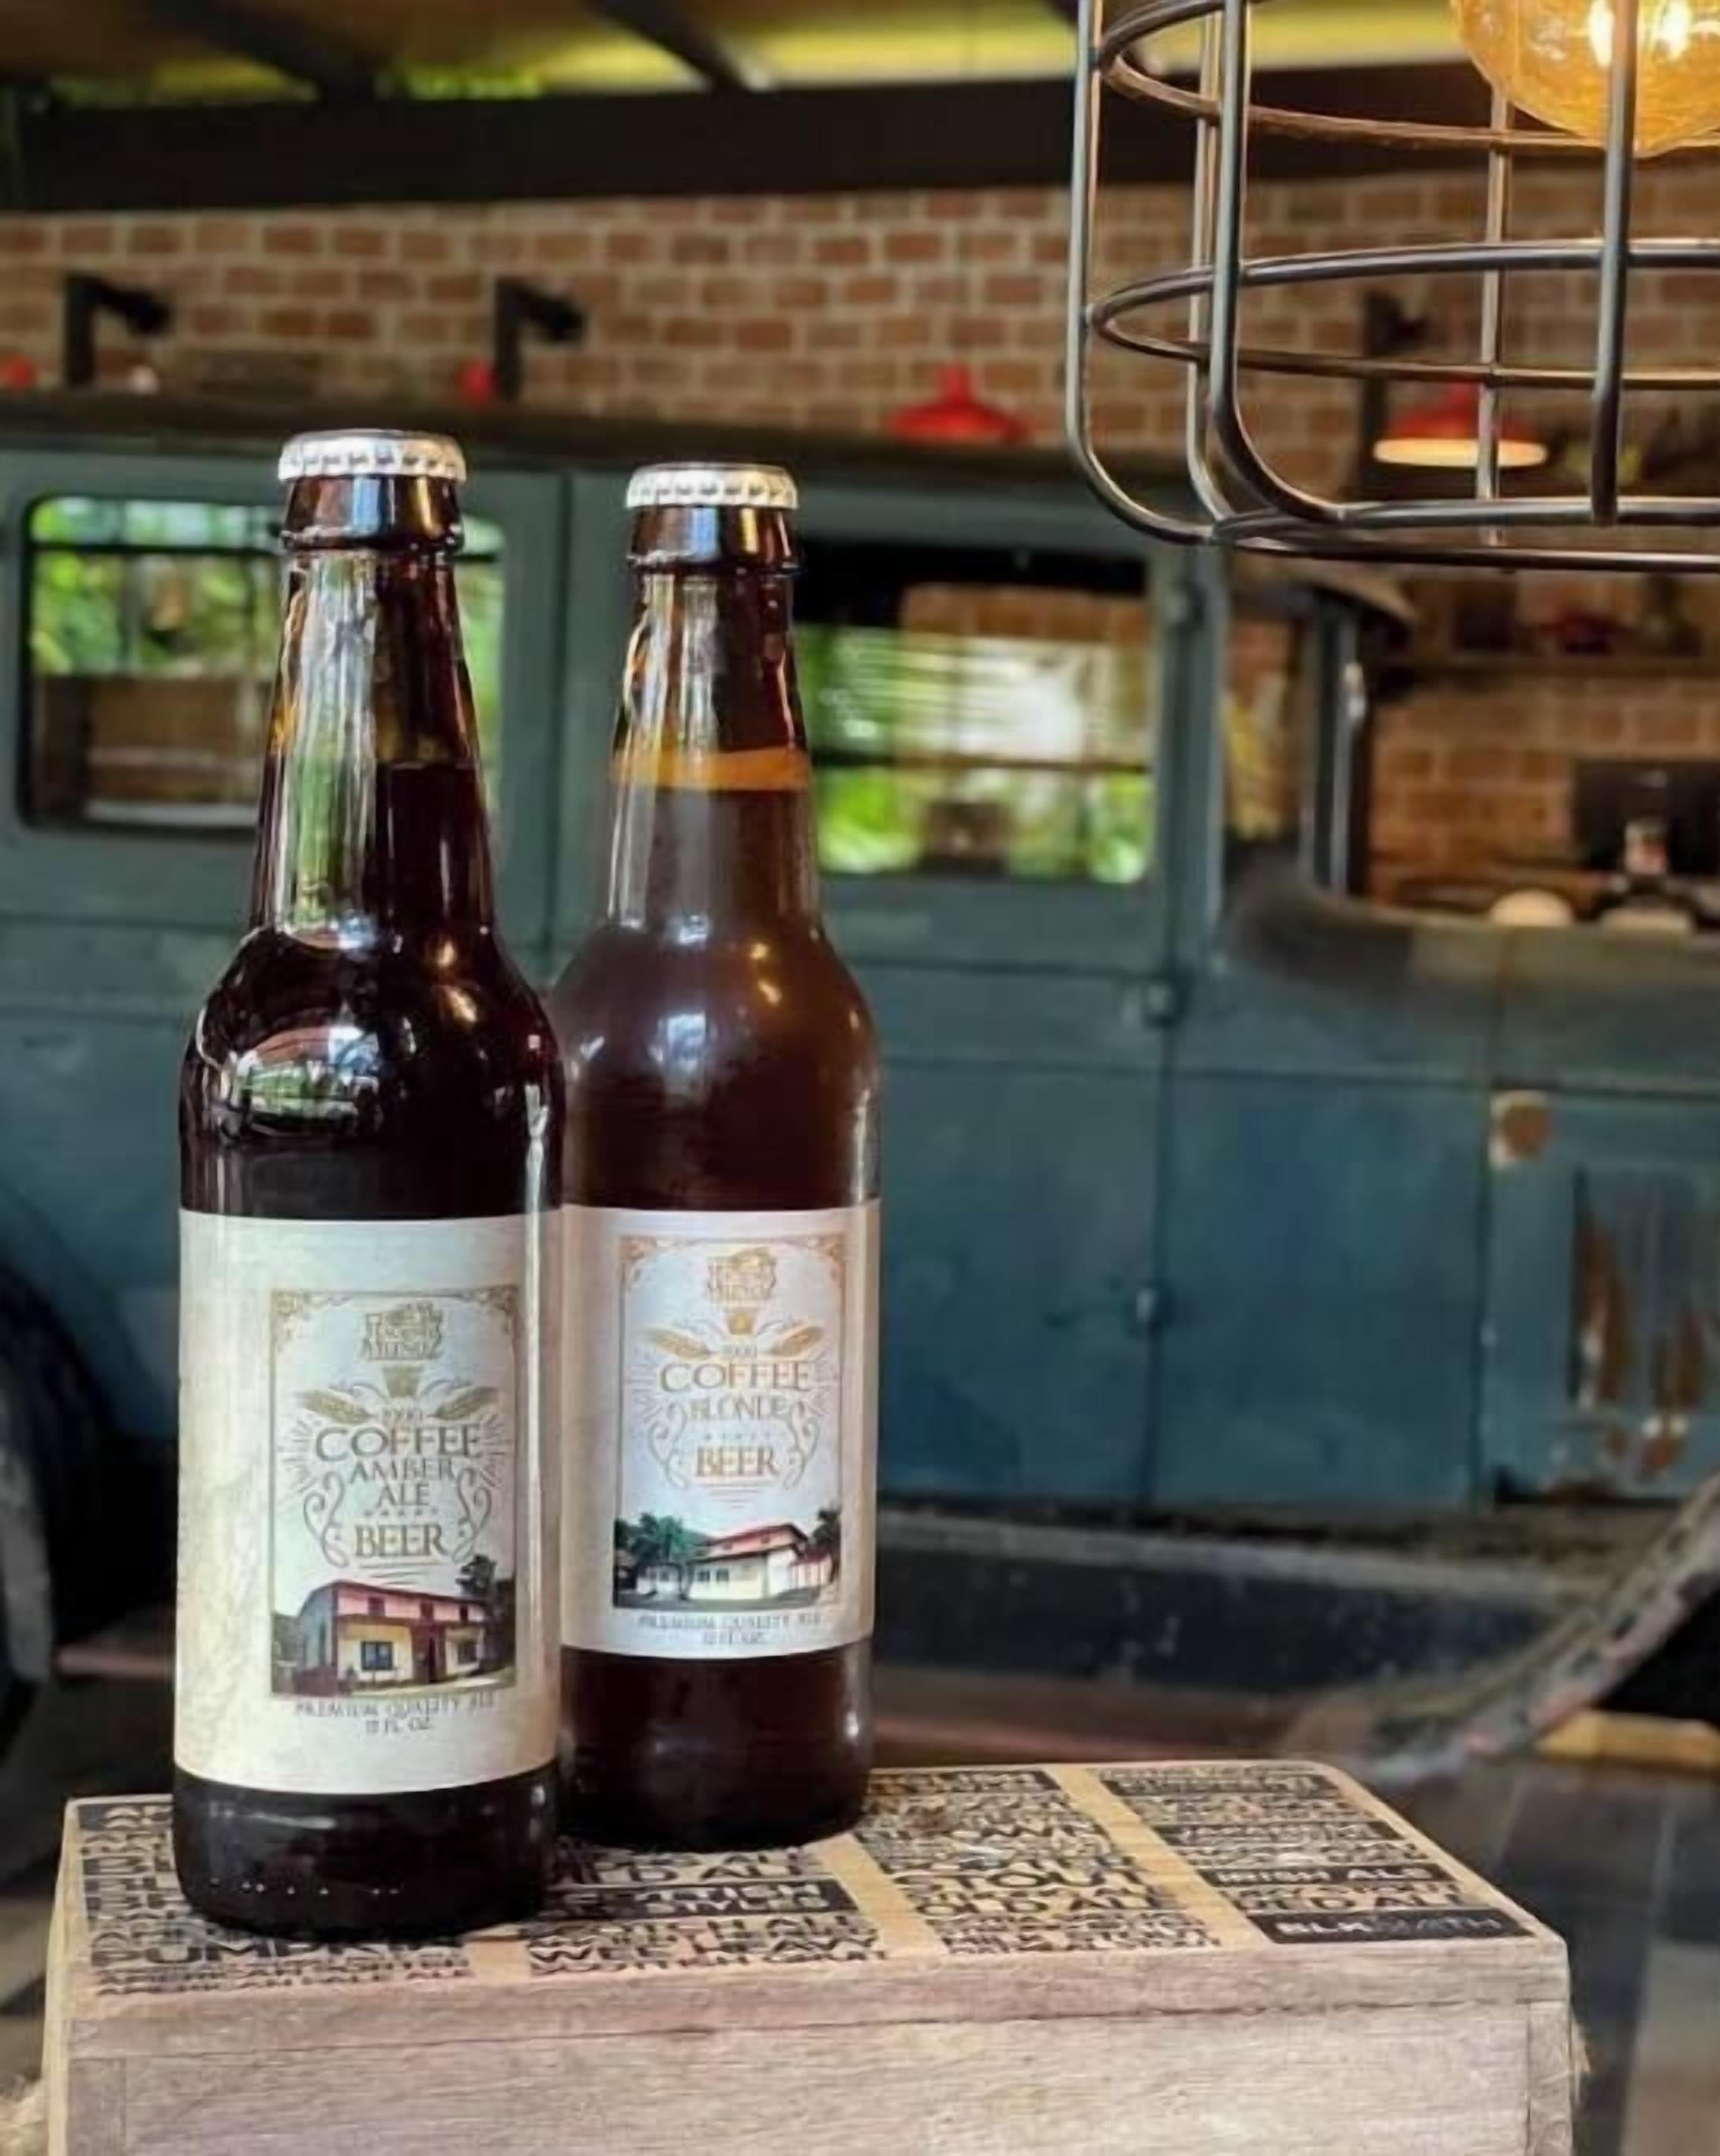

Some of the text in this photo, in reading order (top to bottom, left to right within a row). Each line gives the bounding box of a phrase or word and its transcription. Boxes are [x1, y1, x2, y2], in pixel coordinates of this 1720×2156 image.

[660, 1361, 811, 1392] COFFEE
[690, 1394, 790, 1420] BLONDE
[316, 1424, 483, 1462] COFFEE
[350, 1458, 454, 1484] AMBER
[695, 1446, 780, 1477] BEER
[376, 1483, 429, 1508] ALE
[354, 1523, 452, 1557] BEER
